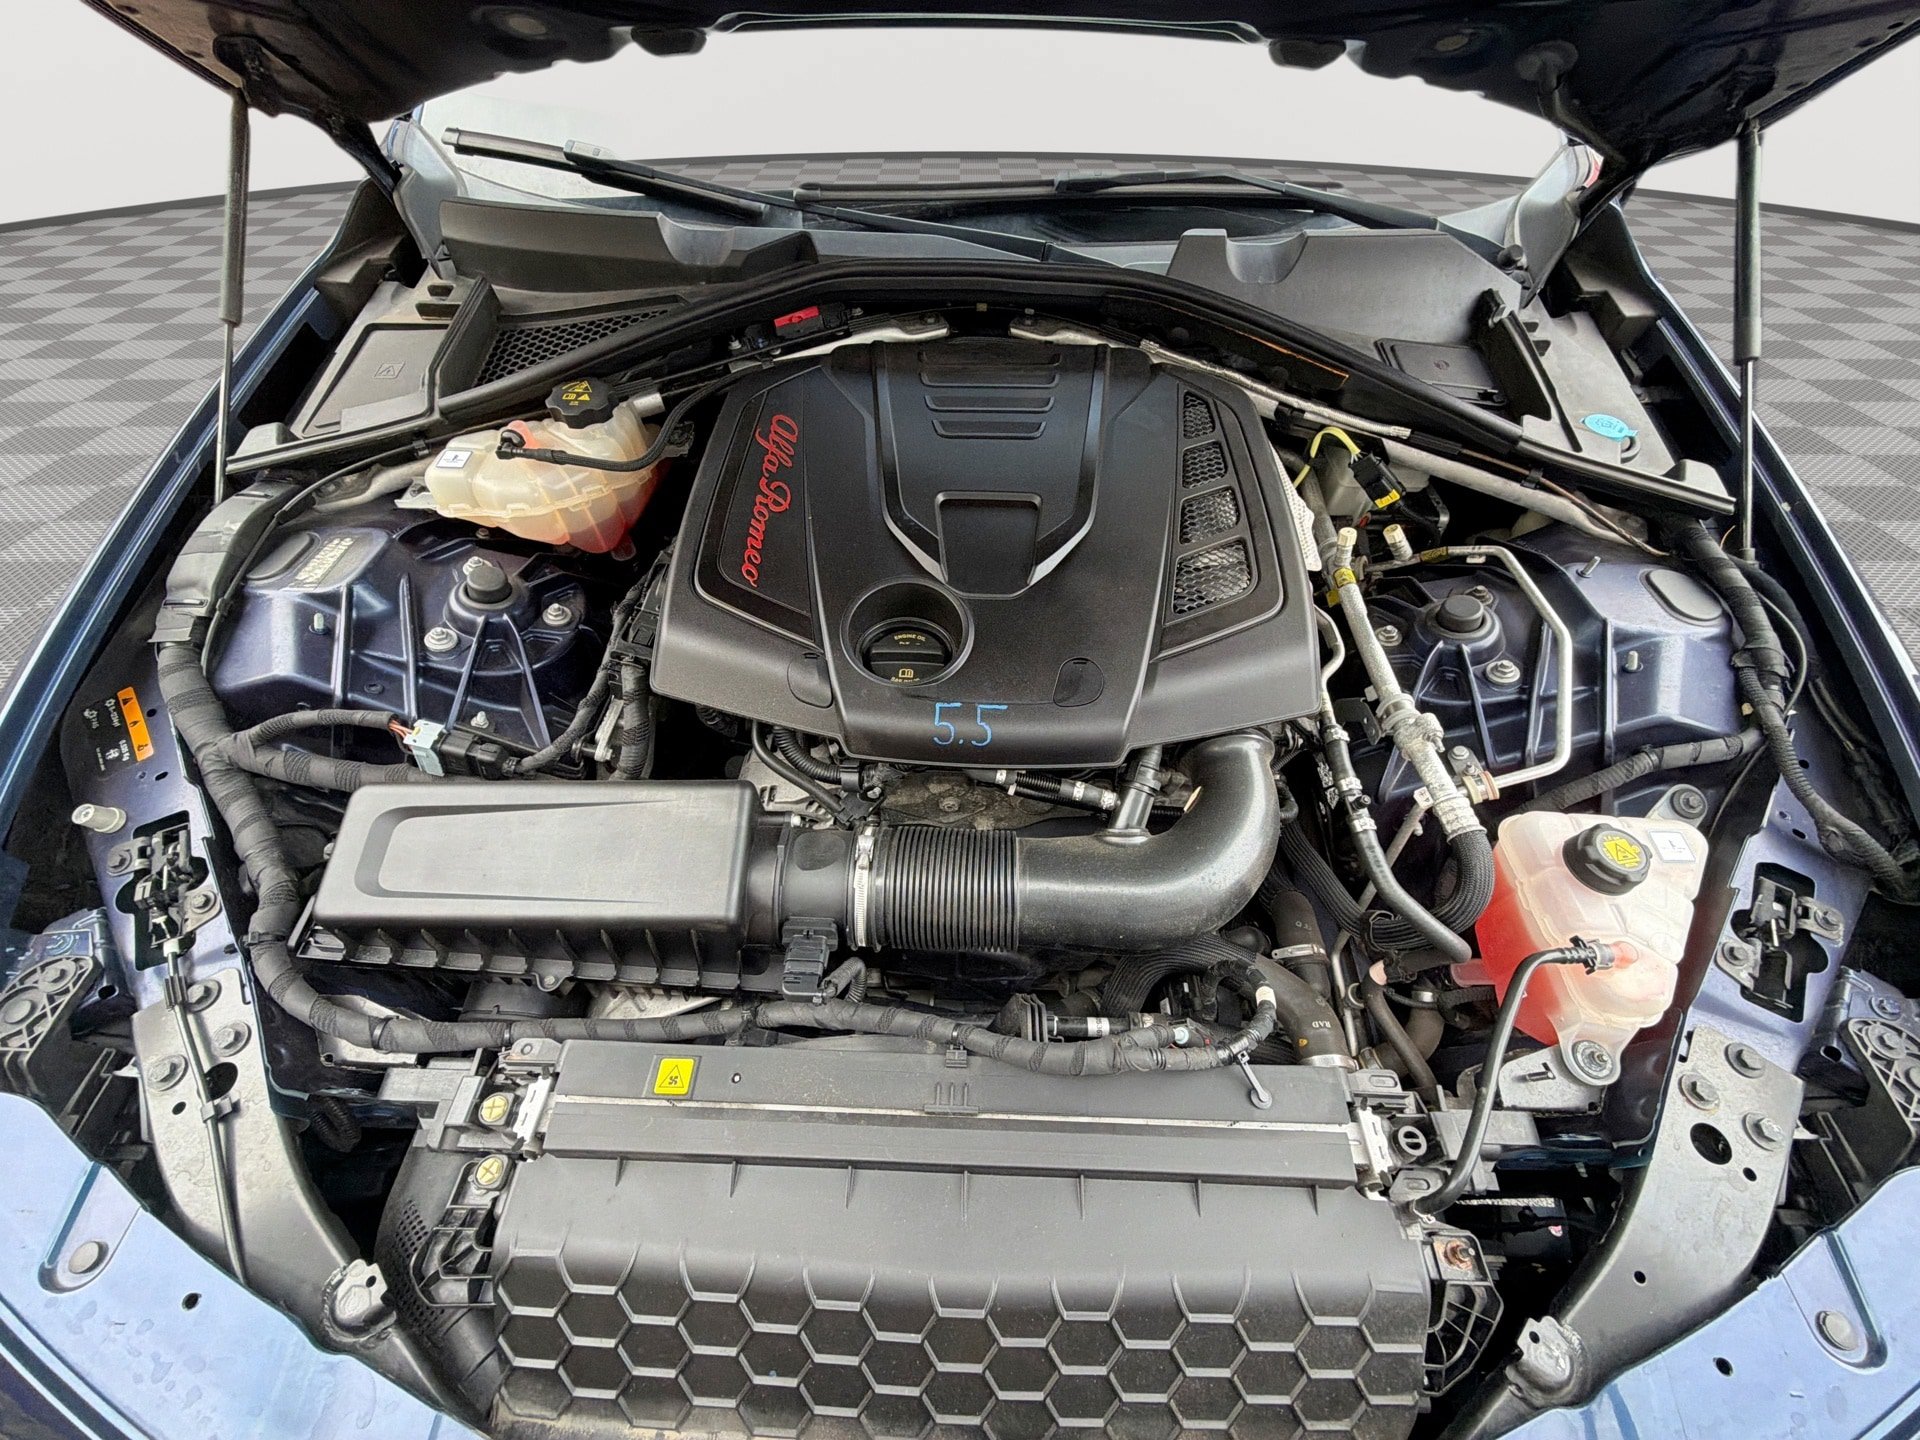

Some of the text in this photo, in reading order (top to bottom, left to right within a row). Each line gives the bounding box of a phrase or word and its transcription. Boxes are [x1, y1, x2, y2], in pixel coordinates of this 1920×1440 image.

[741, 414, 798, 588] Alfa Romeo
[933, 702, 1009, 747] 5.5
[1311, 1020, 1332, 1029] RAD
